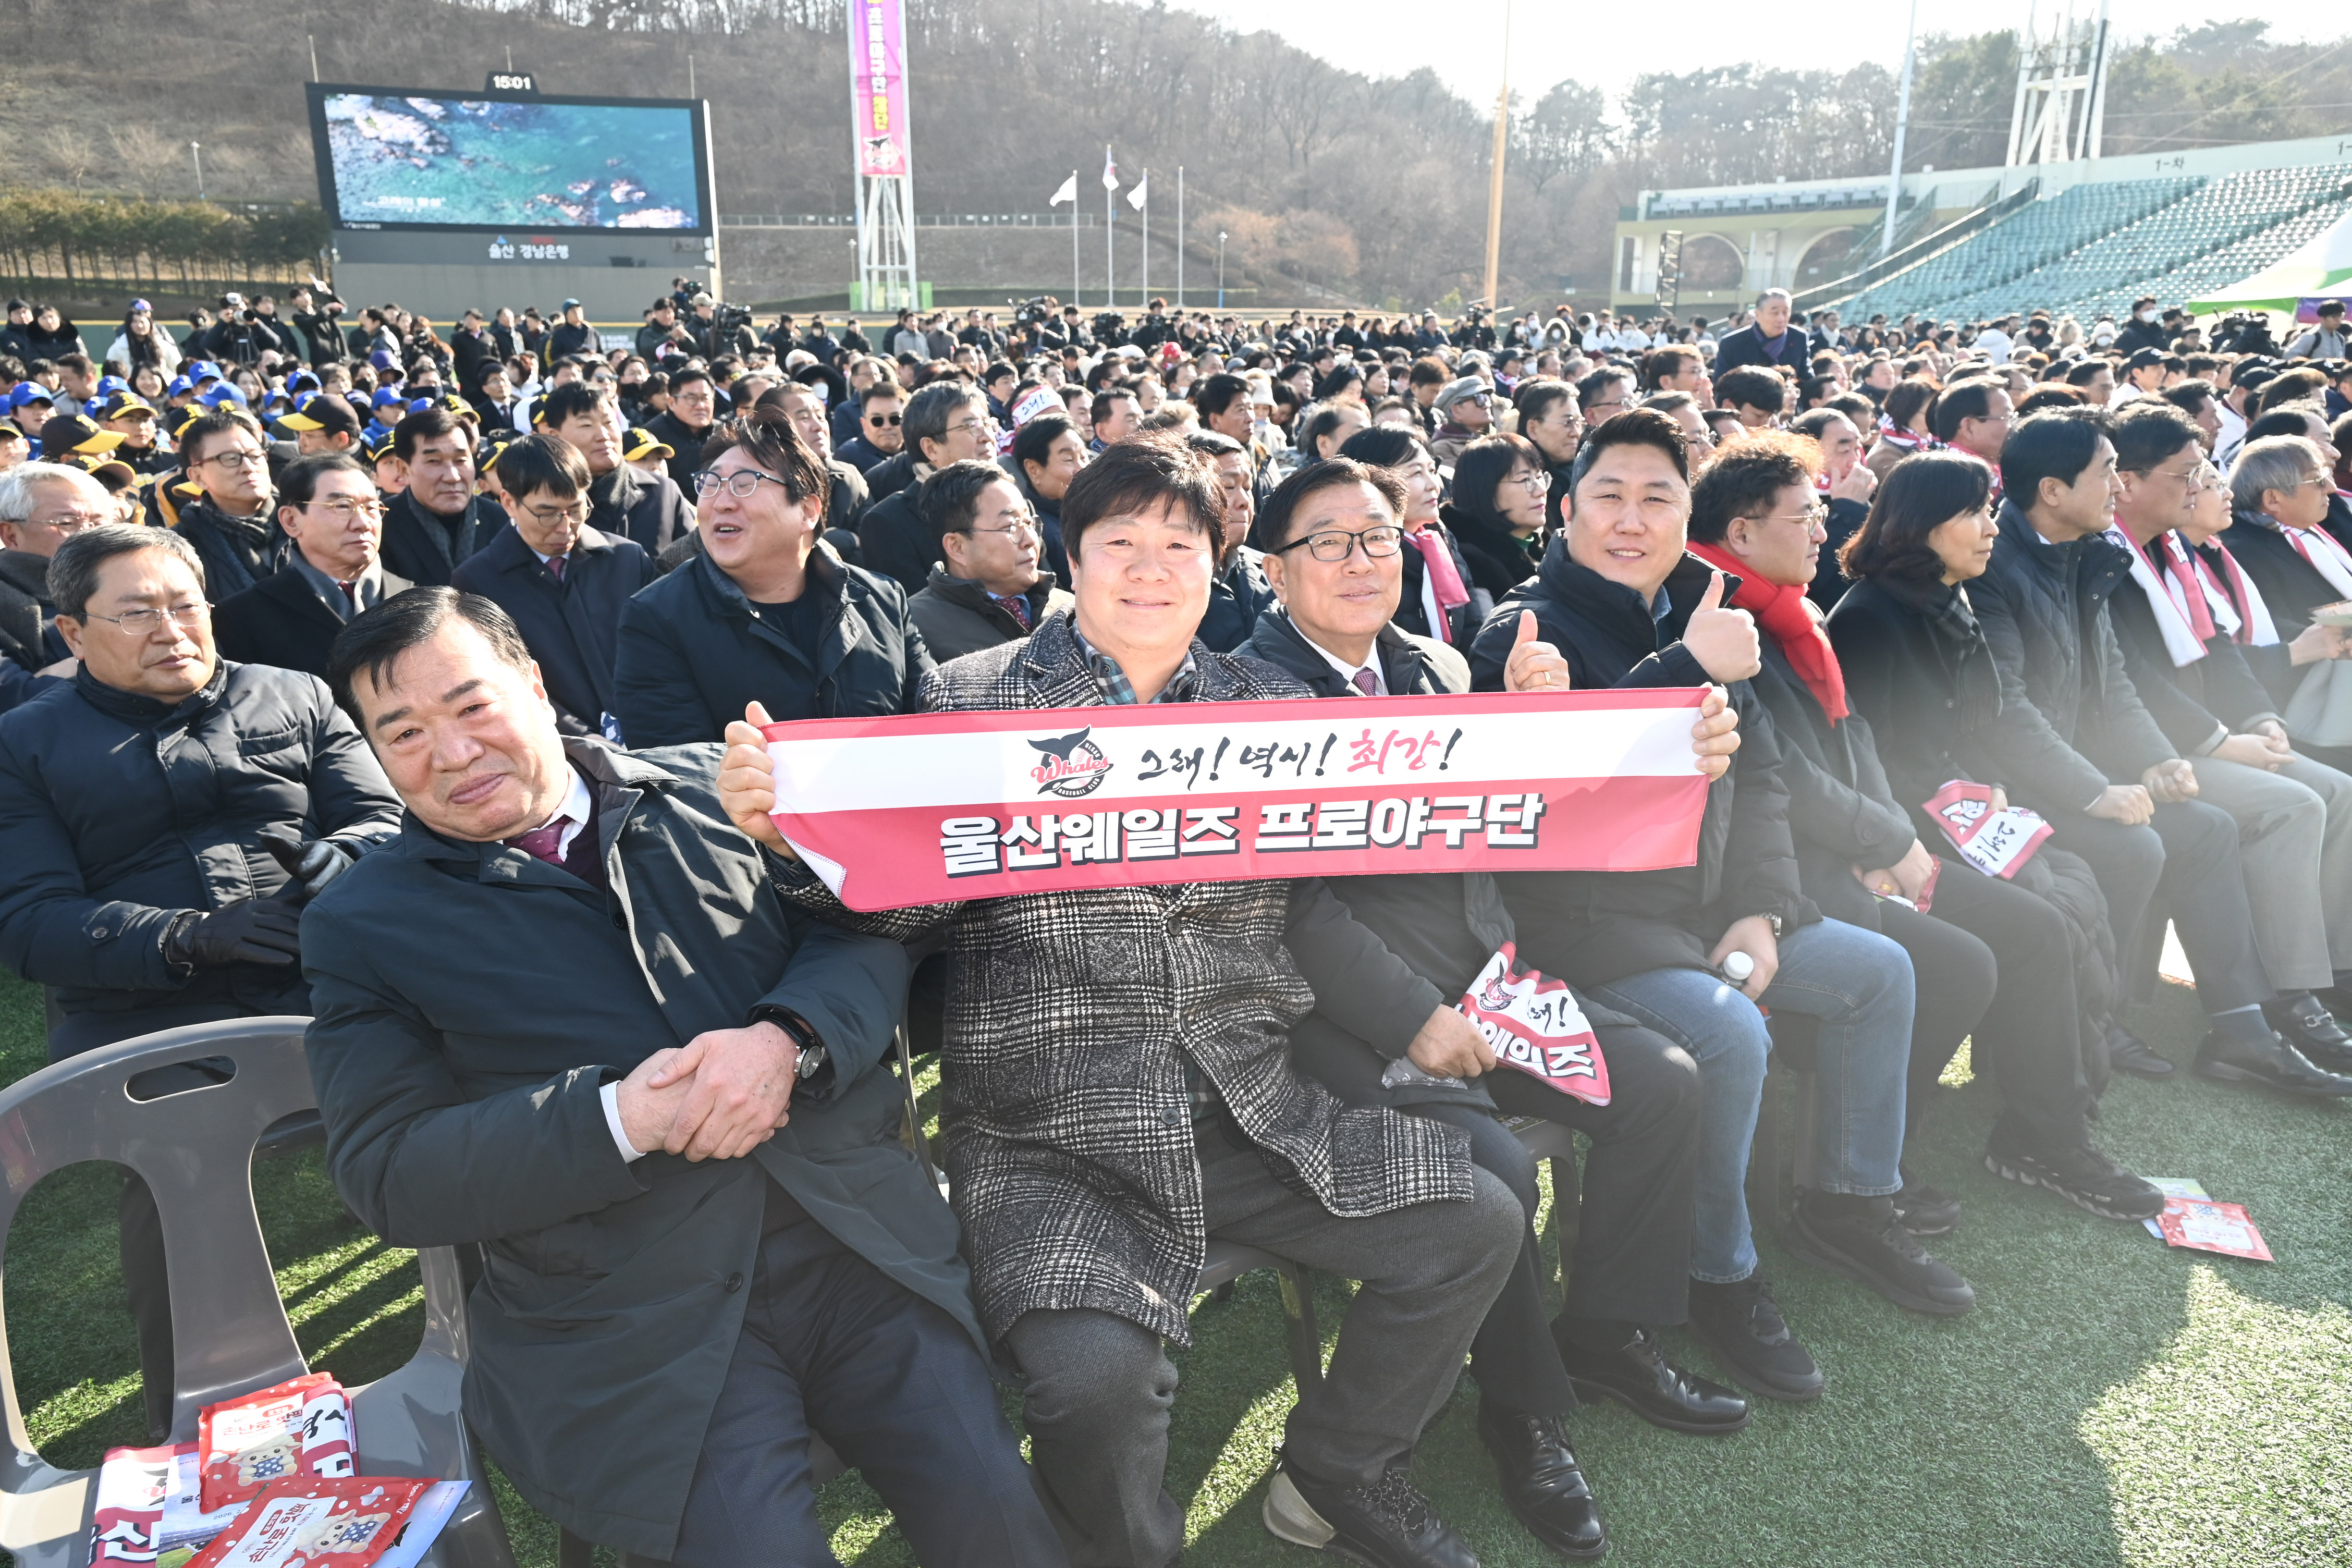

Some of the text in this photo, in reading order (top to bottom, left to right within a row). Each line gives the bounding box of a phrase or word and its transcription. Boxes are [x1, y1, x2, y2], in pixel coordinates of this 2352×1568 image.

[493, 75, 531, 90] 15:01
[488, 243, 570, 260] 울산 경남은행
[1022, 394, 1045, 416] 그래!
[1084, 742, 1101, 758] ULSAN
[1137, 728, 1463, 791] 그래! 역시! 최강!
[1030, 755, 1110, 784] Whales
[1058, 778, 1100, 796] BASEBALL CLUB
[940, 793, 1547, 878] 울산웨일즈 프로야구단
[1527, 996, 1568, 1034] 래!
[222, 1421, 271, 1436] 손난로
[213, 1512, 235, 1520] 2026.
[249, 1526, 290, 1563] 손난로
[279, 1503, 312, 1524] 핫팩
